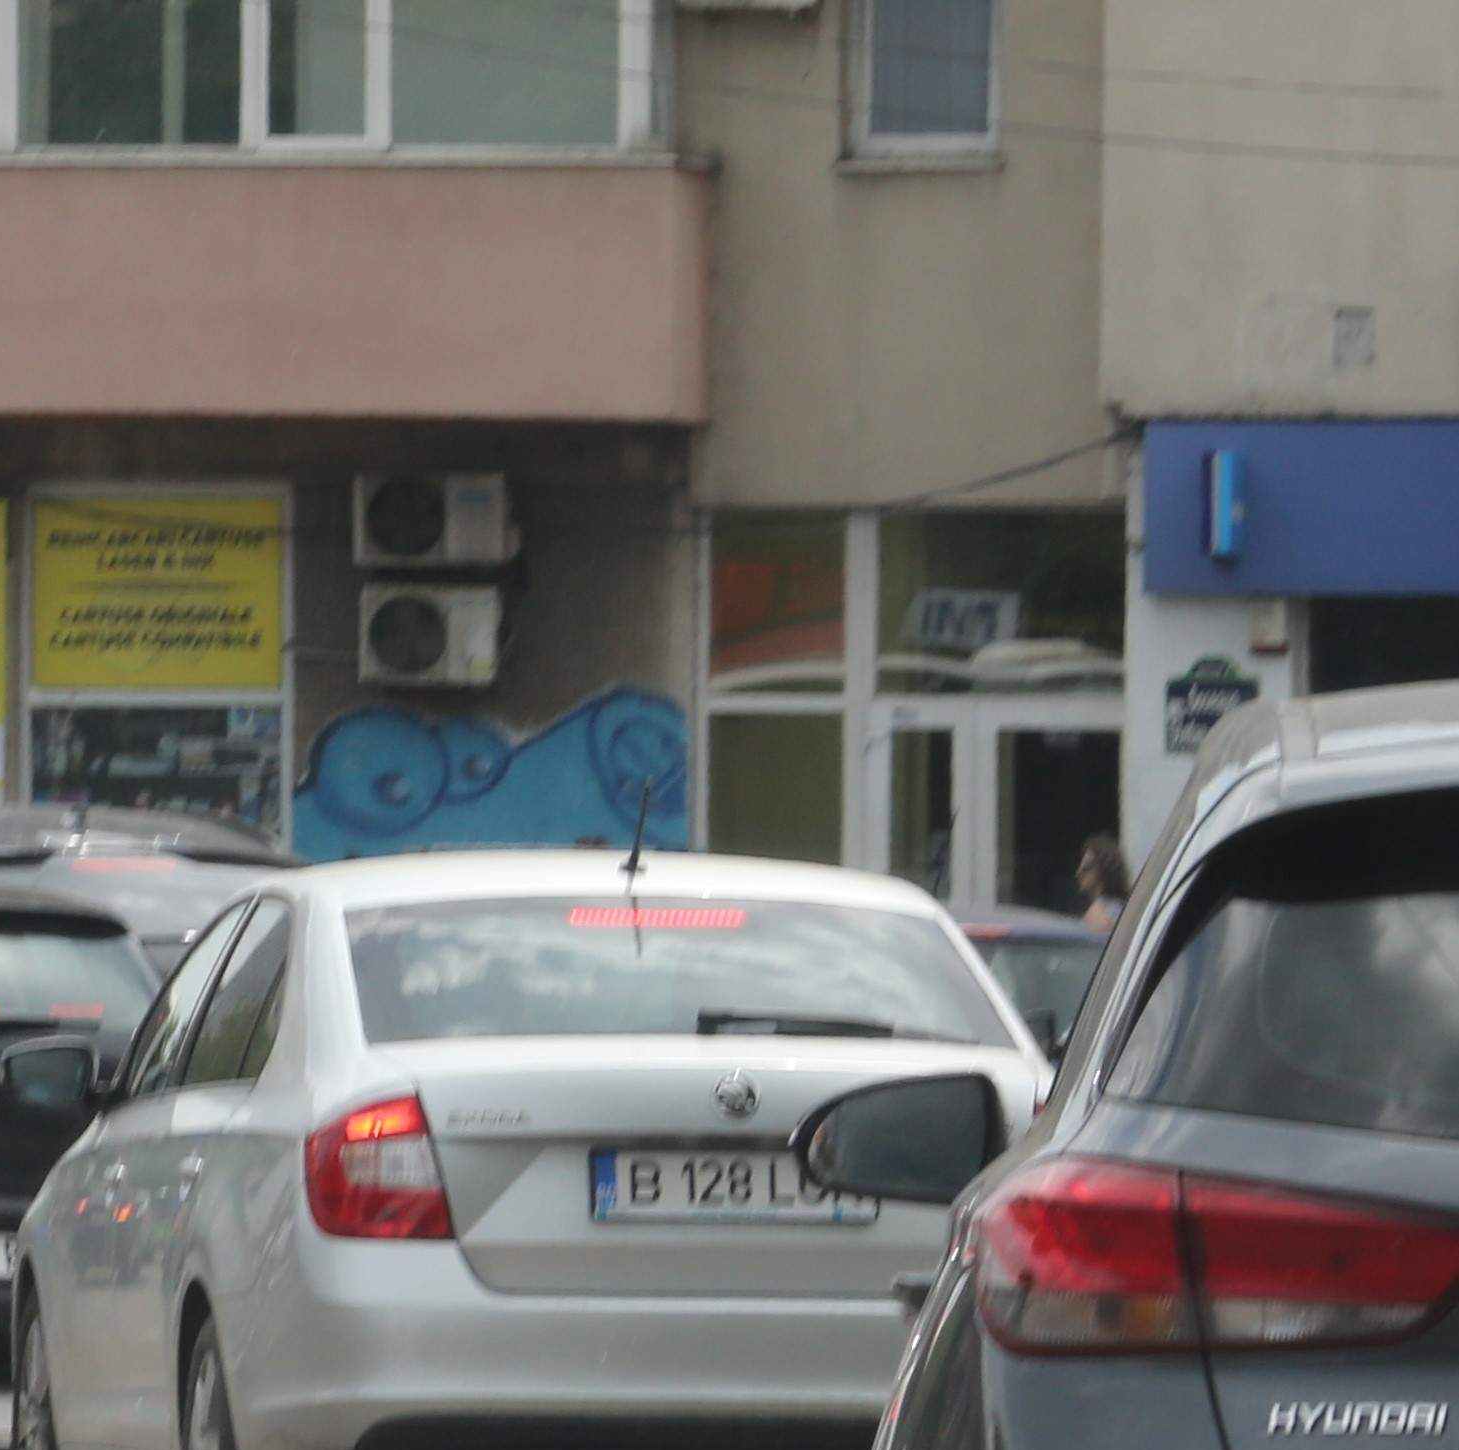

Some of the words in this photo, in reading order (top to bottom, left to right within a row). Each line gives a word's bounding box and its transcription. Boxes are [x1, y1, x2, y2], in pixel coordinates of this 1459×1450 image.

[631, 1157, 661, 1204] B
[682, 1154, 754, 1205] 128
[1266, 1401, 1448, 1436] HYUNDAI
